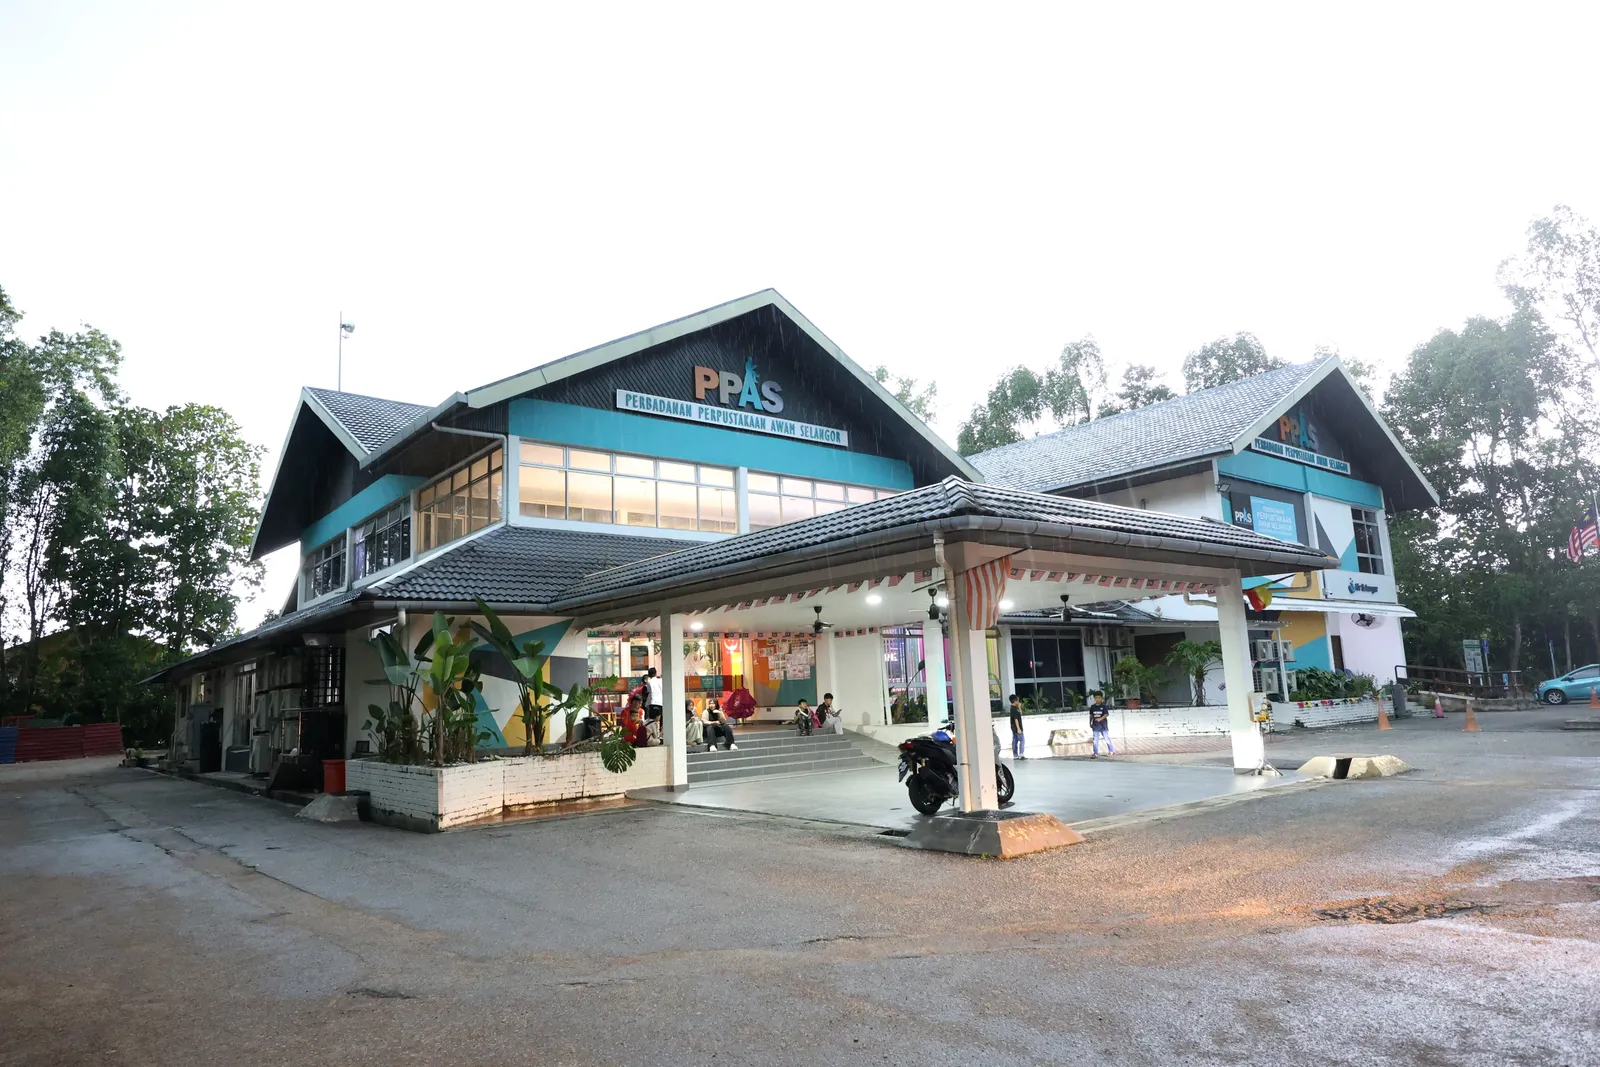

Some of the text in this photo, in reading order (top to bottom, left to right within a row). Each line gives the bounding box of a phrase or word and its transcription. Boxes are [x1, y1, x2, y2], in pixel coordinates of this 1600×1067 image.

[695, 358, 784, 413] PPAS
[625, 393, 841, 443] PERBADANAN PERPUSTAKAAN AWAM SELANGOR
[1279, 411, 1319, 452] PPAS
[1234, 507, 1252, 523] PPAS
